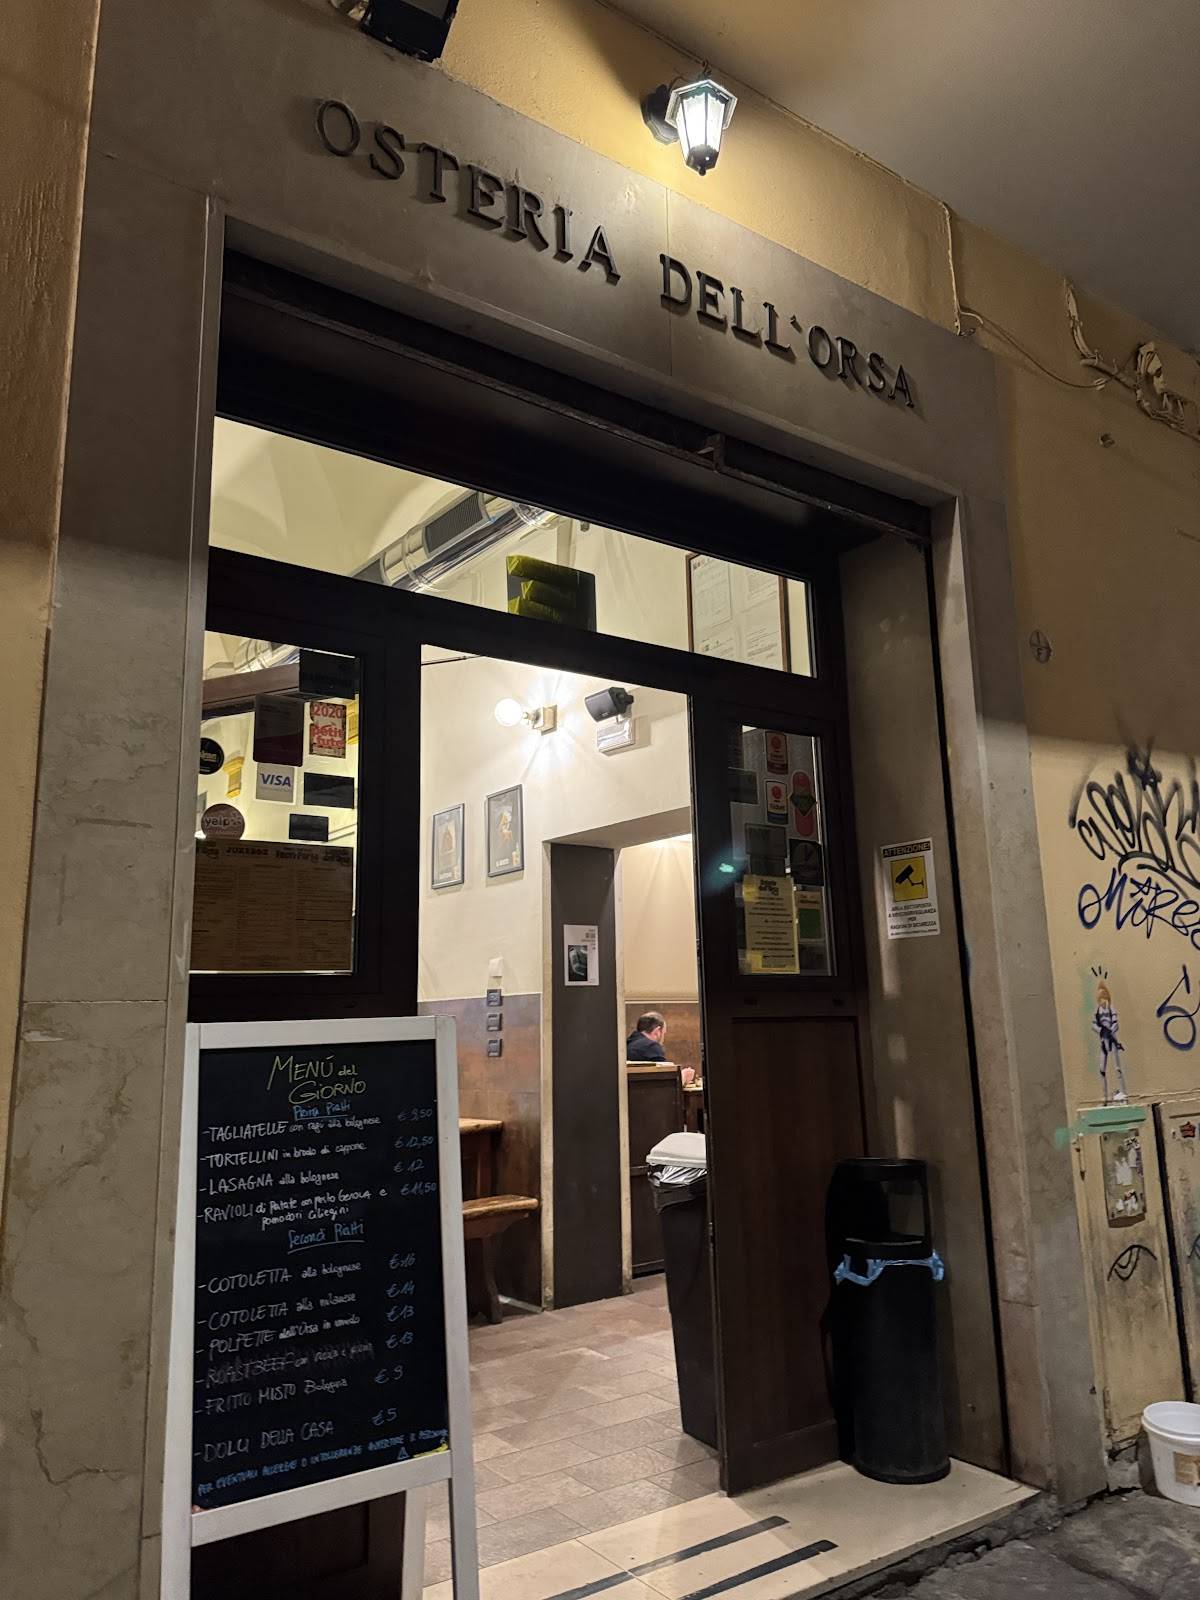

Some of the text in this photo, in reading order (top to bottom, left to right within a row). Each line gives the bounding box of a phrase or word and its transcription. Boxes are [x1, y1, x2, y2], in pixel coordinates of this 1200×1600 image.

[314, 99, 916, 408] OSTERIA DELL'ORSA
[313, 703, 343, 719] 2020
[259, 773, 292, 787] VISA
[204, 815, 231, 828] yelp
[338, 1065, 358, 1077] del
[258, 1383, 297, 1404] MISTO
[301, 1420, 335, 1441] CASA
